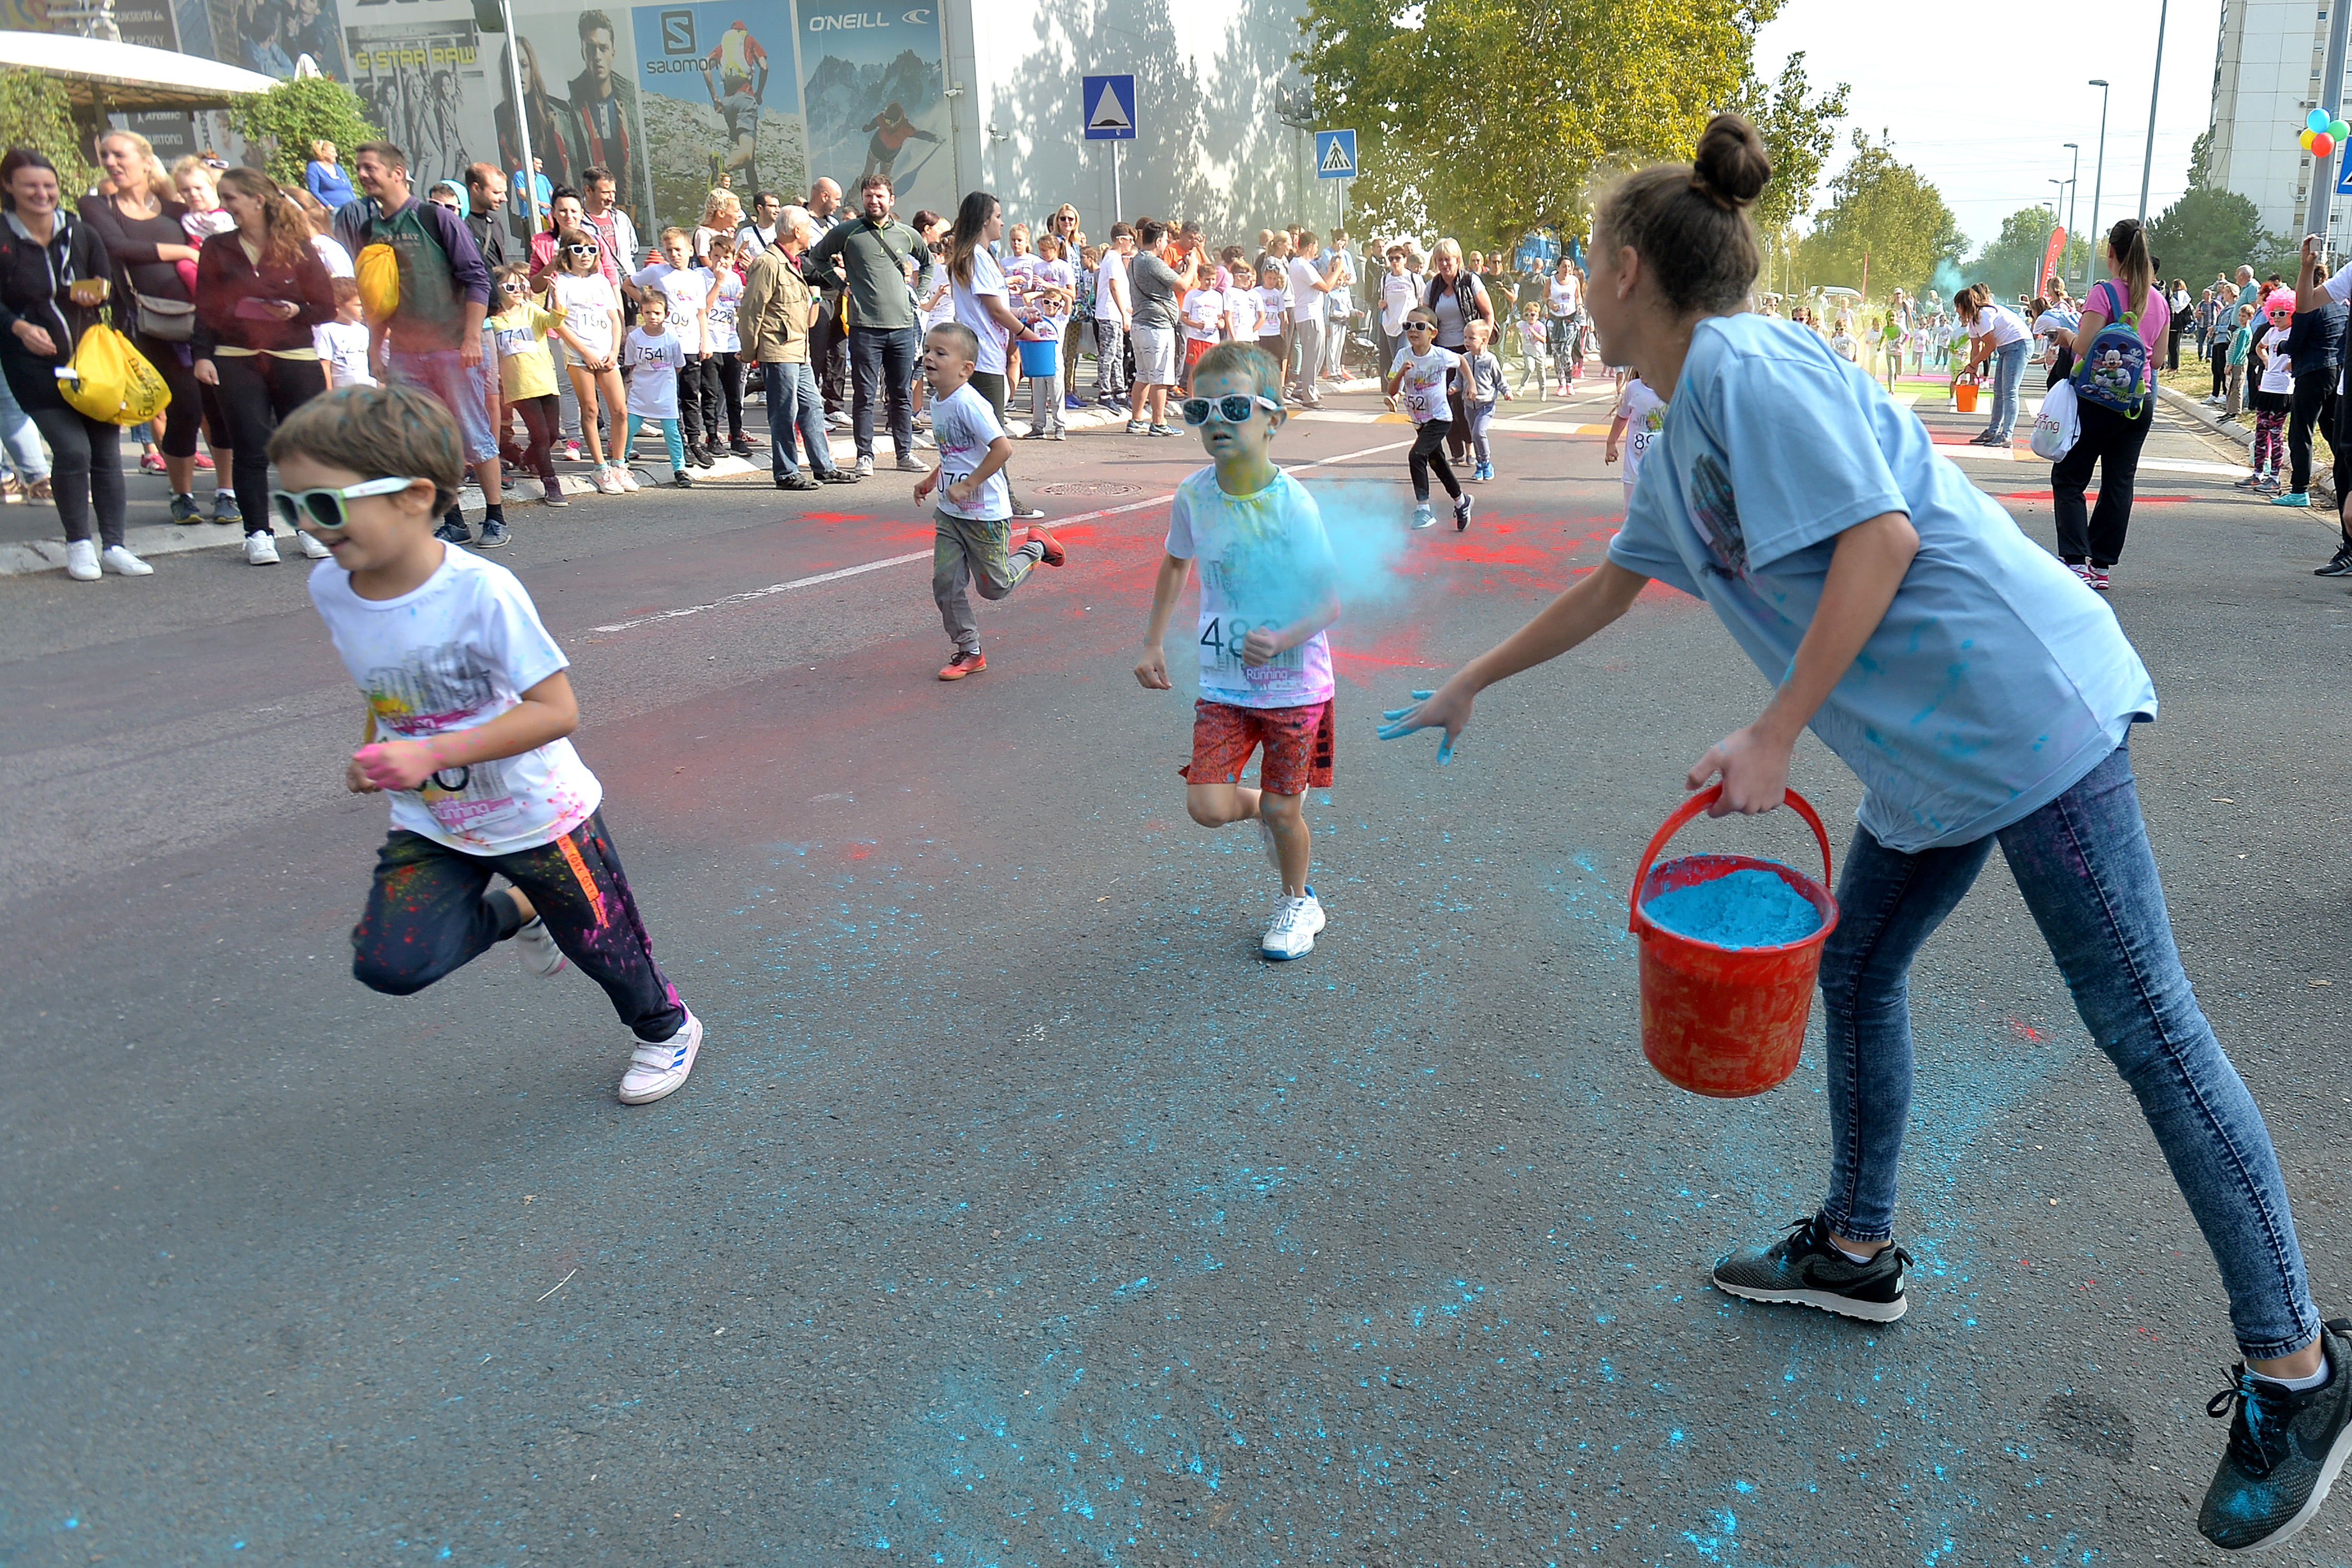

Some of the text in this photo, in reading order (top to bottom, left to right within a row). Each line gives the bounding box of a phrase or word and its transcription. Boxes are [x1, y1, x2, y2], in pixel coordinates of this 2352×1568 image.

[114, 10, 154, 22] UIKSILVER
[810, 12, 890, 31] O'NEILL
[355, 46, 476, 70] G-STAR RAW
[146, 111, 180, 121] ATOMIC
[146, 134, 177, 145] URTON
[709, 308, 732, 325] 228
[496, 328, 526, 347] 771
[637, 347, 664, 361] 754
